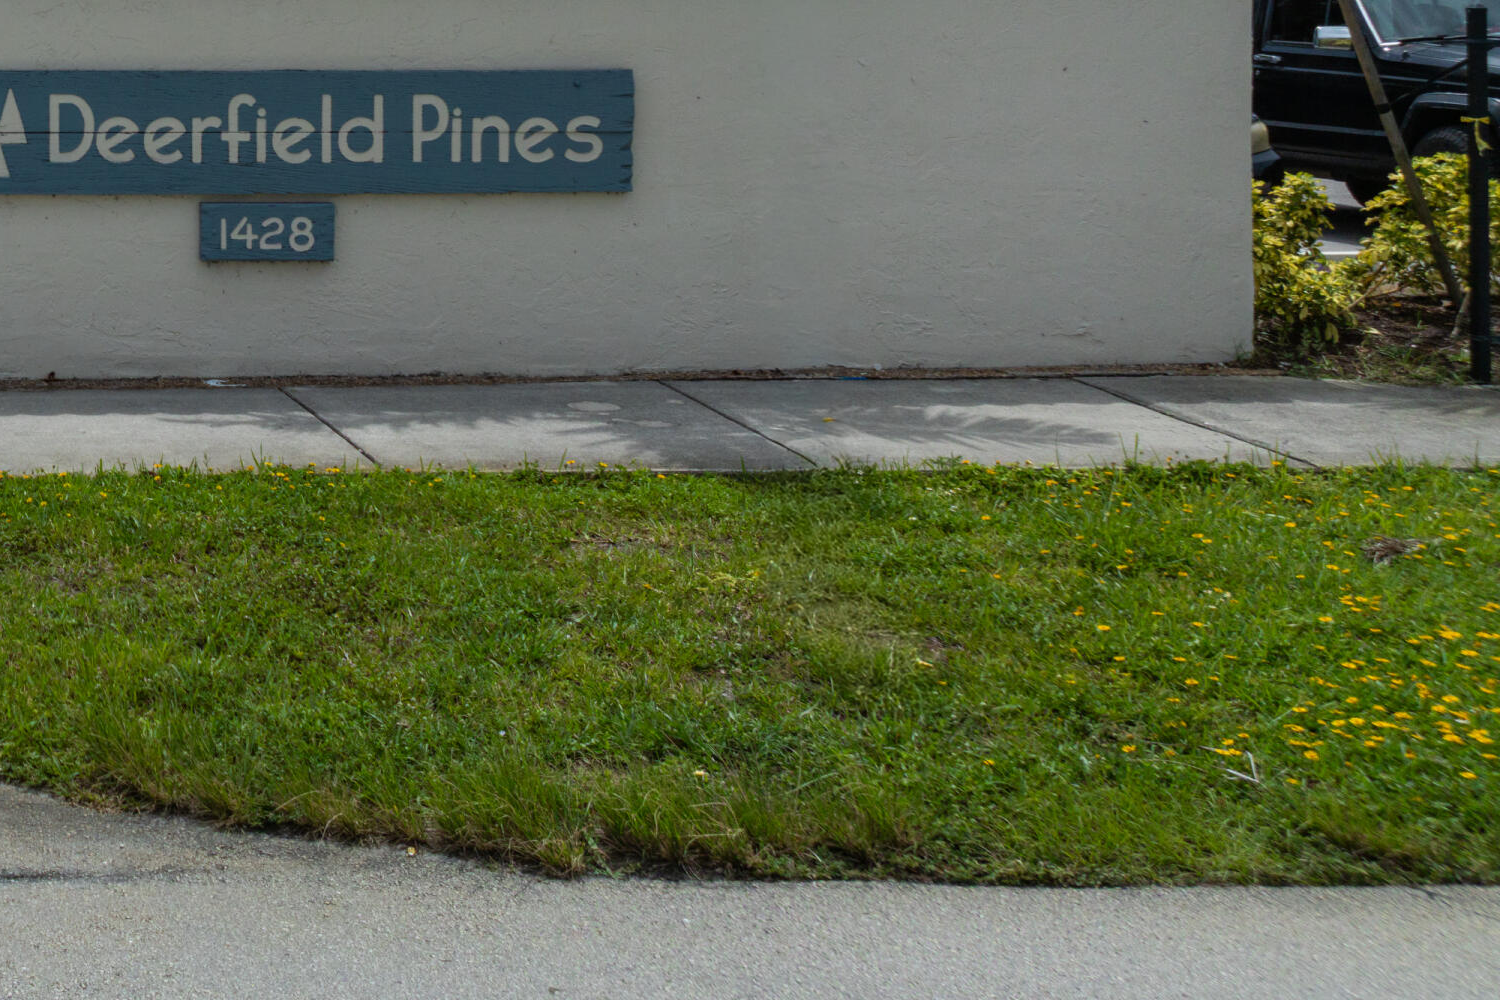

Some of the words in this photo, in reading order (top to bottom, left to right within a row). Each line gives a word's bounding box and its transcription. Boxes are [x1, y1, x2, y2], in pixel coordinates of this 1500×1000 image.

[49, 94, 384, 164] Deerfield
[413, 95, 602, 163] Pines
[220, 217, 315, 252] 1428
